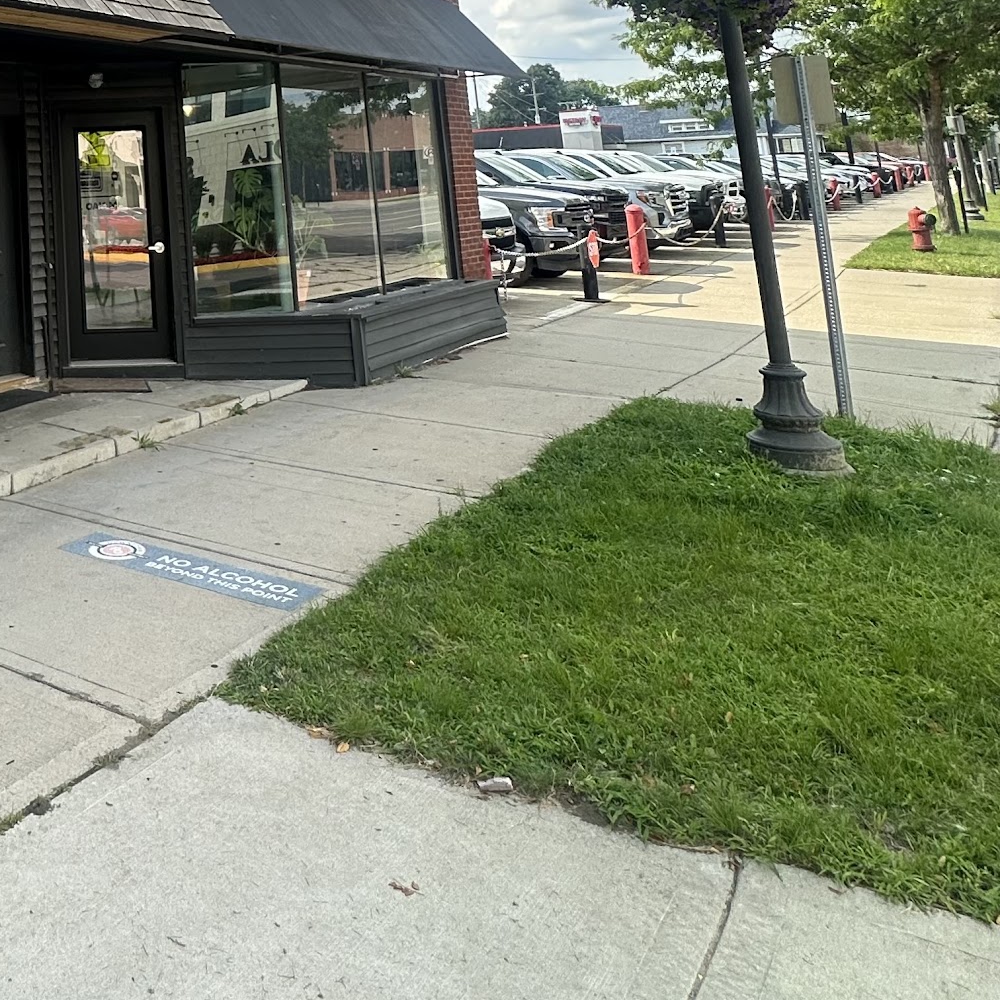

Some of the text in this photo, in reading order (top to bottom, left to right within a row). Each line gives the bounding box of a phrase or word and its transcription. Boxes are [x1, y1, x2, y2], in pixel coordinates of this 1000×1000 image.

[144, 561, 293, 603] BEYOND THIS POINT
[156, 555, 299, 598] NO ALCOHOL
